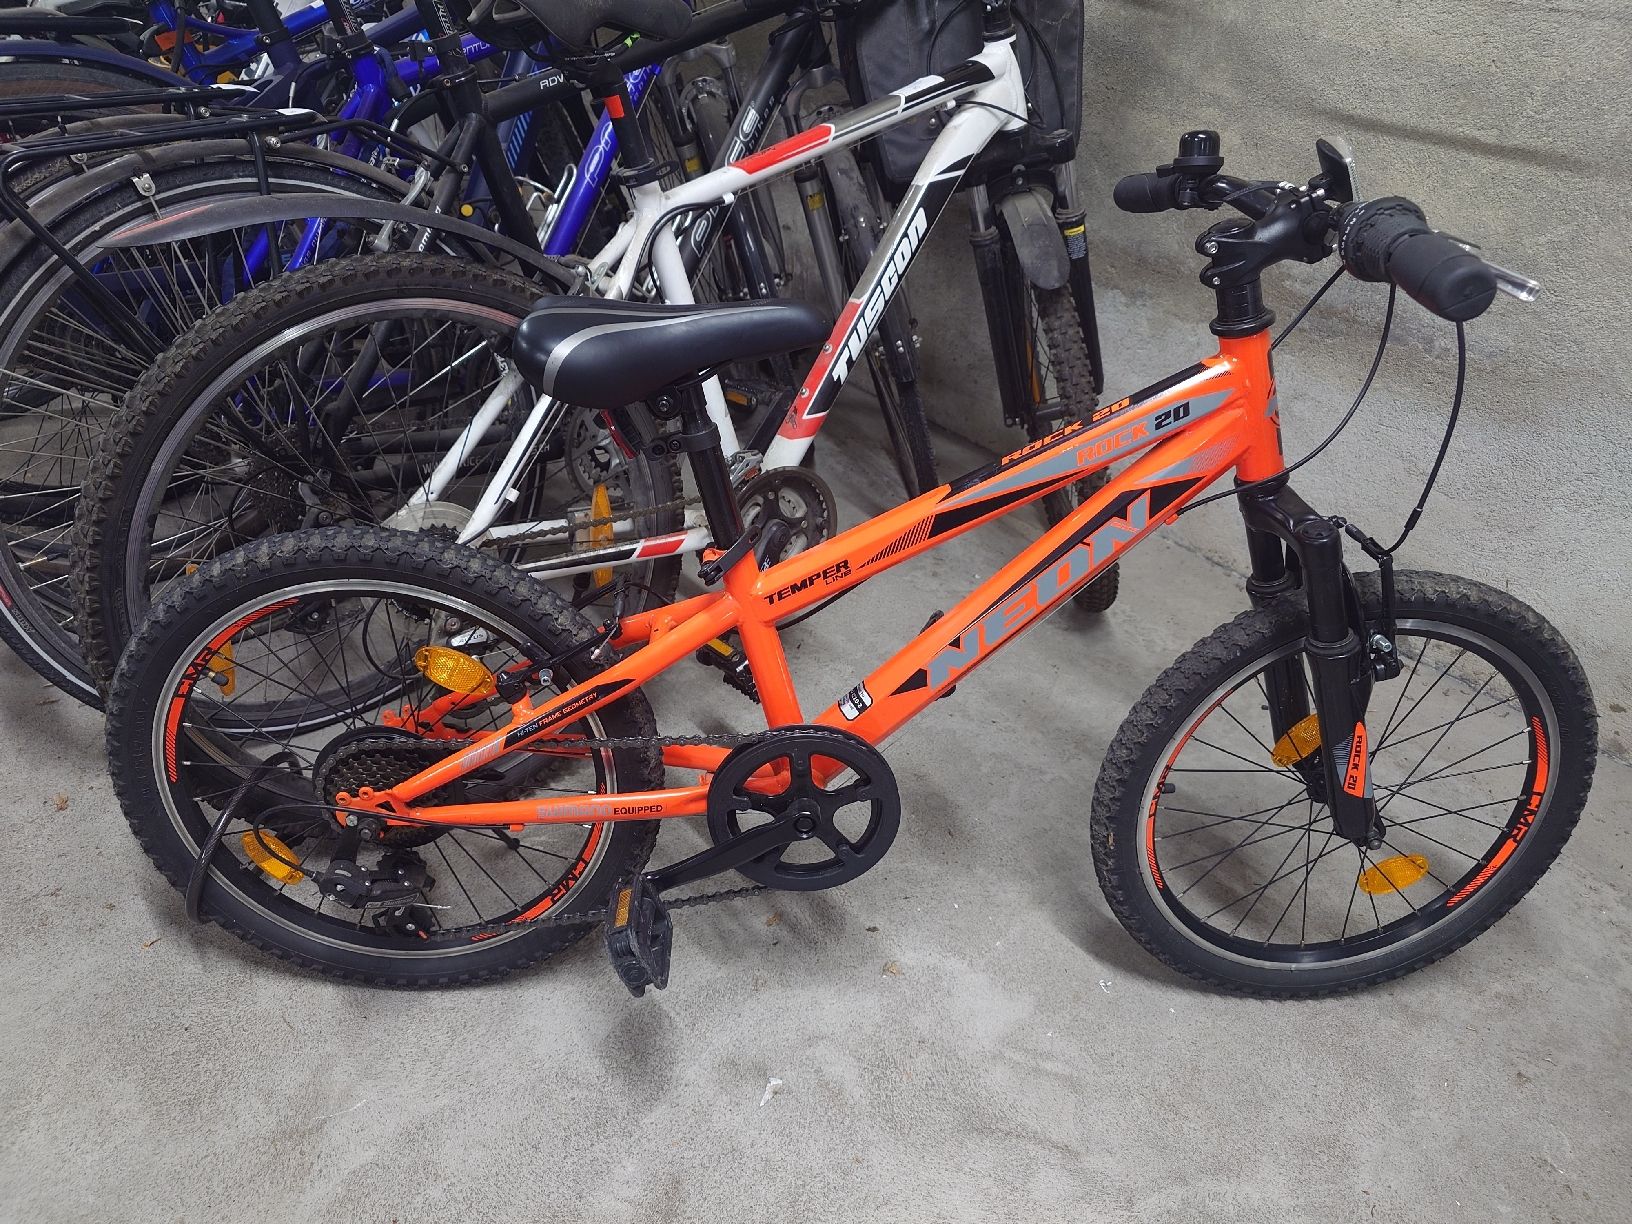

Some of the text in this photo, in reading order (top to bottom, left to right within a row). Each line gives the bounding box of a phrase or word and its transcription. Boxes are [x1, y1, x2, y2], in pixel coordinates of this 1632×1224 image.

[832, 206, 928, 385] TUSCON
[1001, 397, 1131, 466] ROCK 20
[1077, 401, 1191, 467] ROCK 20
[763, 559, 850, 606] TEMPER
[824, 569, 852, 586] LINE
[926, 488, 1151, 690] NEON
[538, 710, 562, 728] FRAME
[562, 691, 598, 715] GEOMETRY
[1346, 734, 1363, 791] ROCK 20
[613, 804, 664, 816] EQUIPPED
